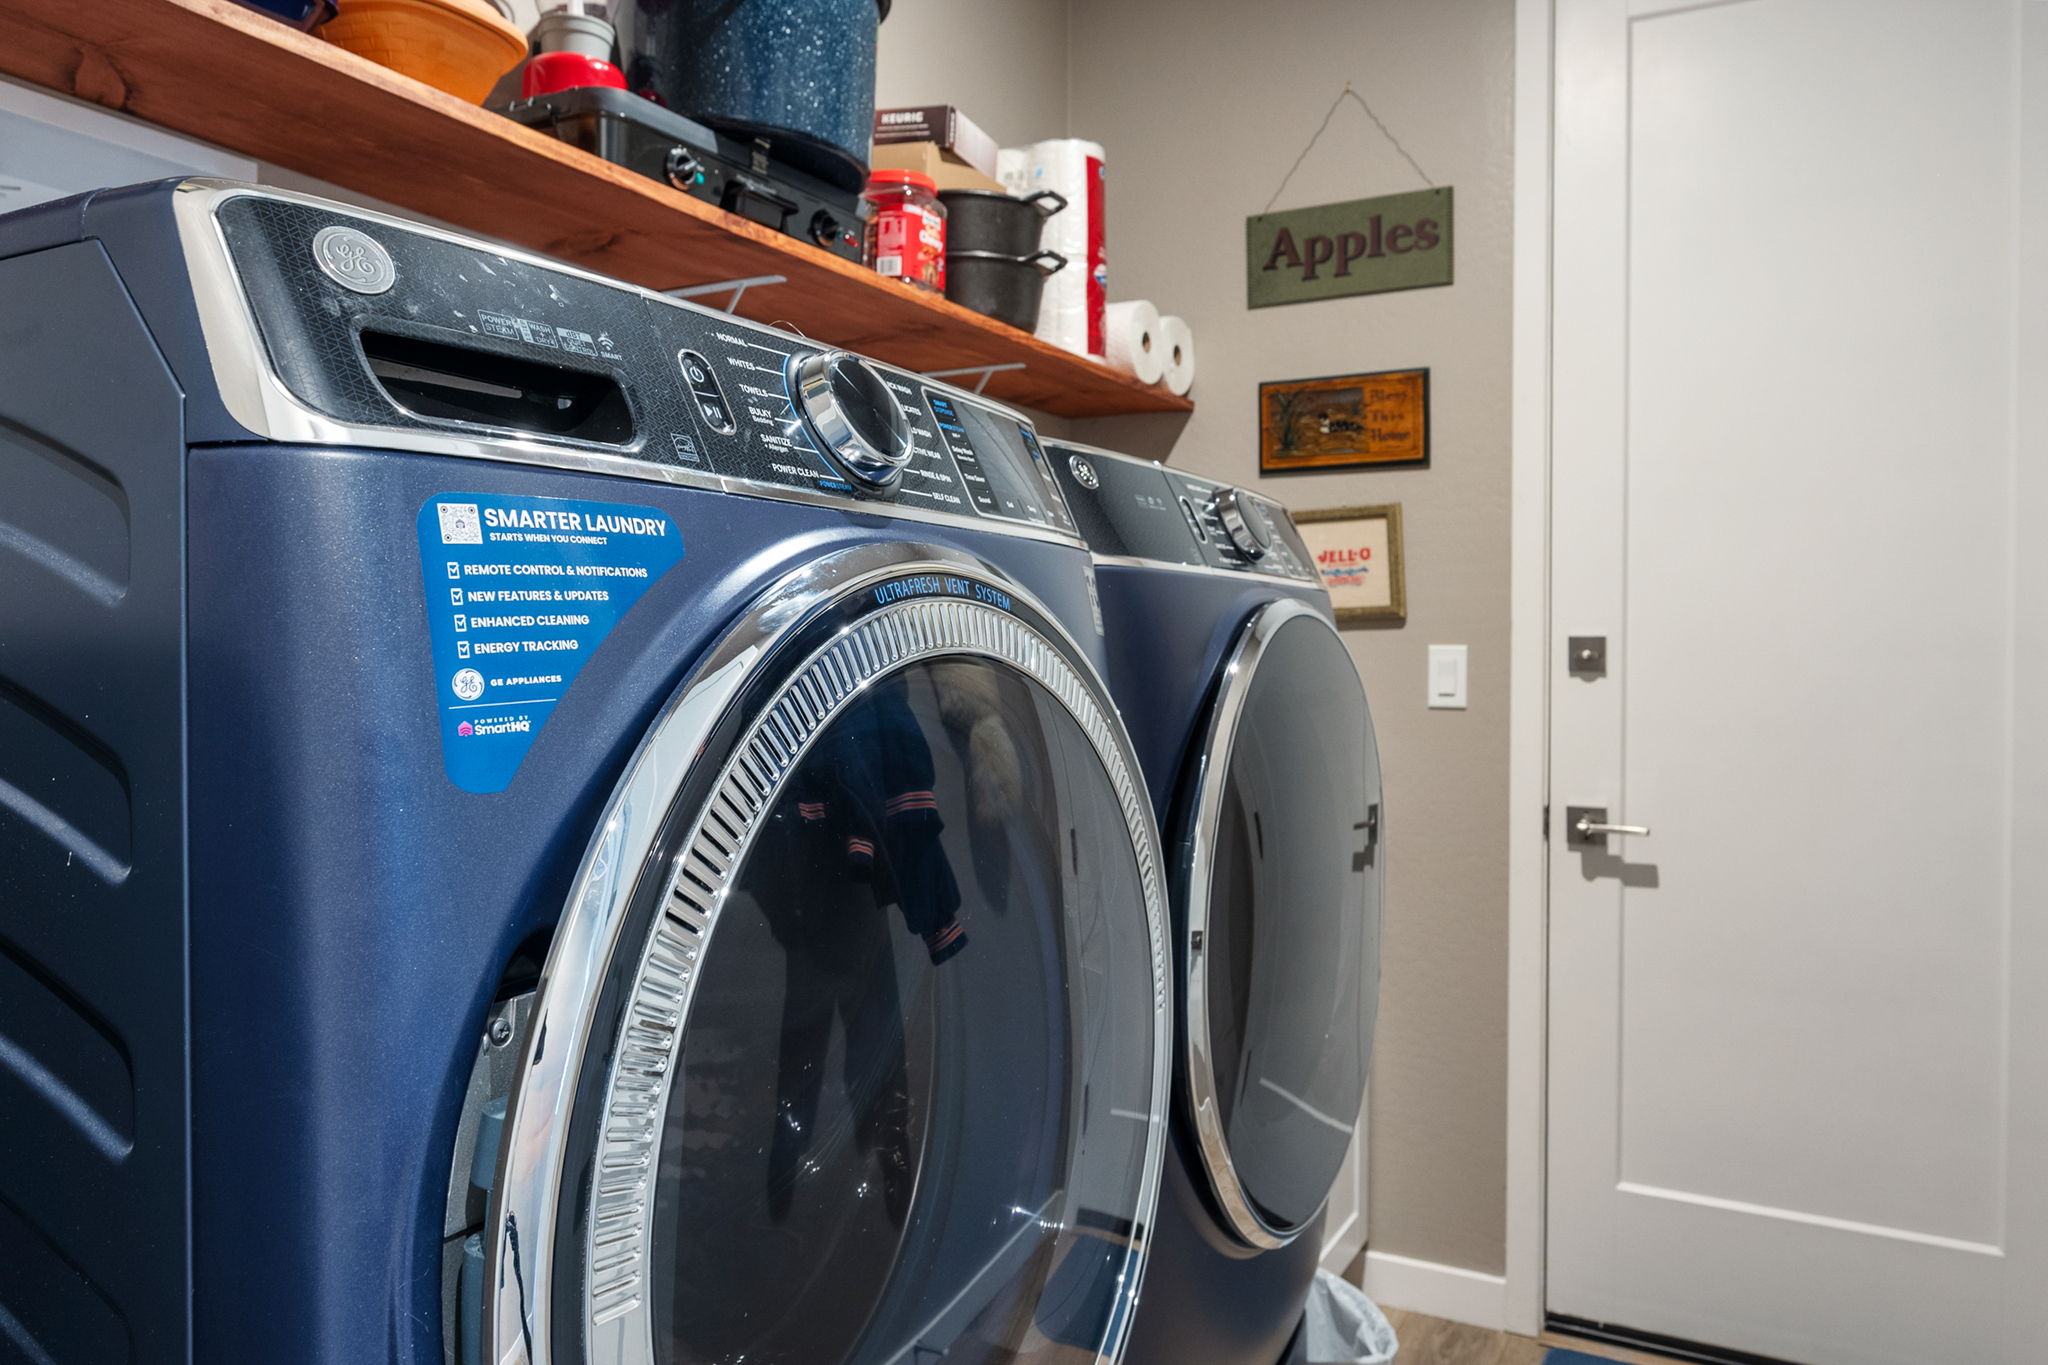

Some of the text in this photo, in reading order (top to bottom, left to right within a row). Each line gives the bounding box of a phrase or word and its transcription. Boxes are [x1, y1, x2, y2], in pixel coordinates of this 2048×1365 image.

[1262, 213, 1440, 282] Apples
[481, 314, 512, 326] POWER
[486, 324, 514, 336] STEAM
[529, 322, 550, 334] WASH
[716, 332, 748, 347] NORMAL
[600, 352, 622, 361] SMART
[727, 357, 756, 370] WHITES
[739, 384, 768, 397] TOWELS
[749, 406, 772, 418] BULKY
[760, 434, 792, 447] SANITIZE
[772, 463, 820, 478] POWER CLEAN
[932, 492, 961, 504] SELF CLEAN
[484, 508, 666, 537] SMARTER LAUNDRY
[490, 532, 608, 546] STARTS WHEN YOU CONNECT
[464, 564, 648, 578] REMOTE CONTROL & NOTIFICATIONS
[468, 590, 609, 602] NEW FEATURES & UPDATES
[875, 576, 1011, 611] ULTRAFRESH VENT SYSTEM
[470, 614, 590, 628] ENHANCED CLEANING
[474, 640, 578, 654] ENERGY TRACKING
[490, 675, 562, 687] GE APPLIANCES
[474, 716, 514, 724] POWERED
